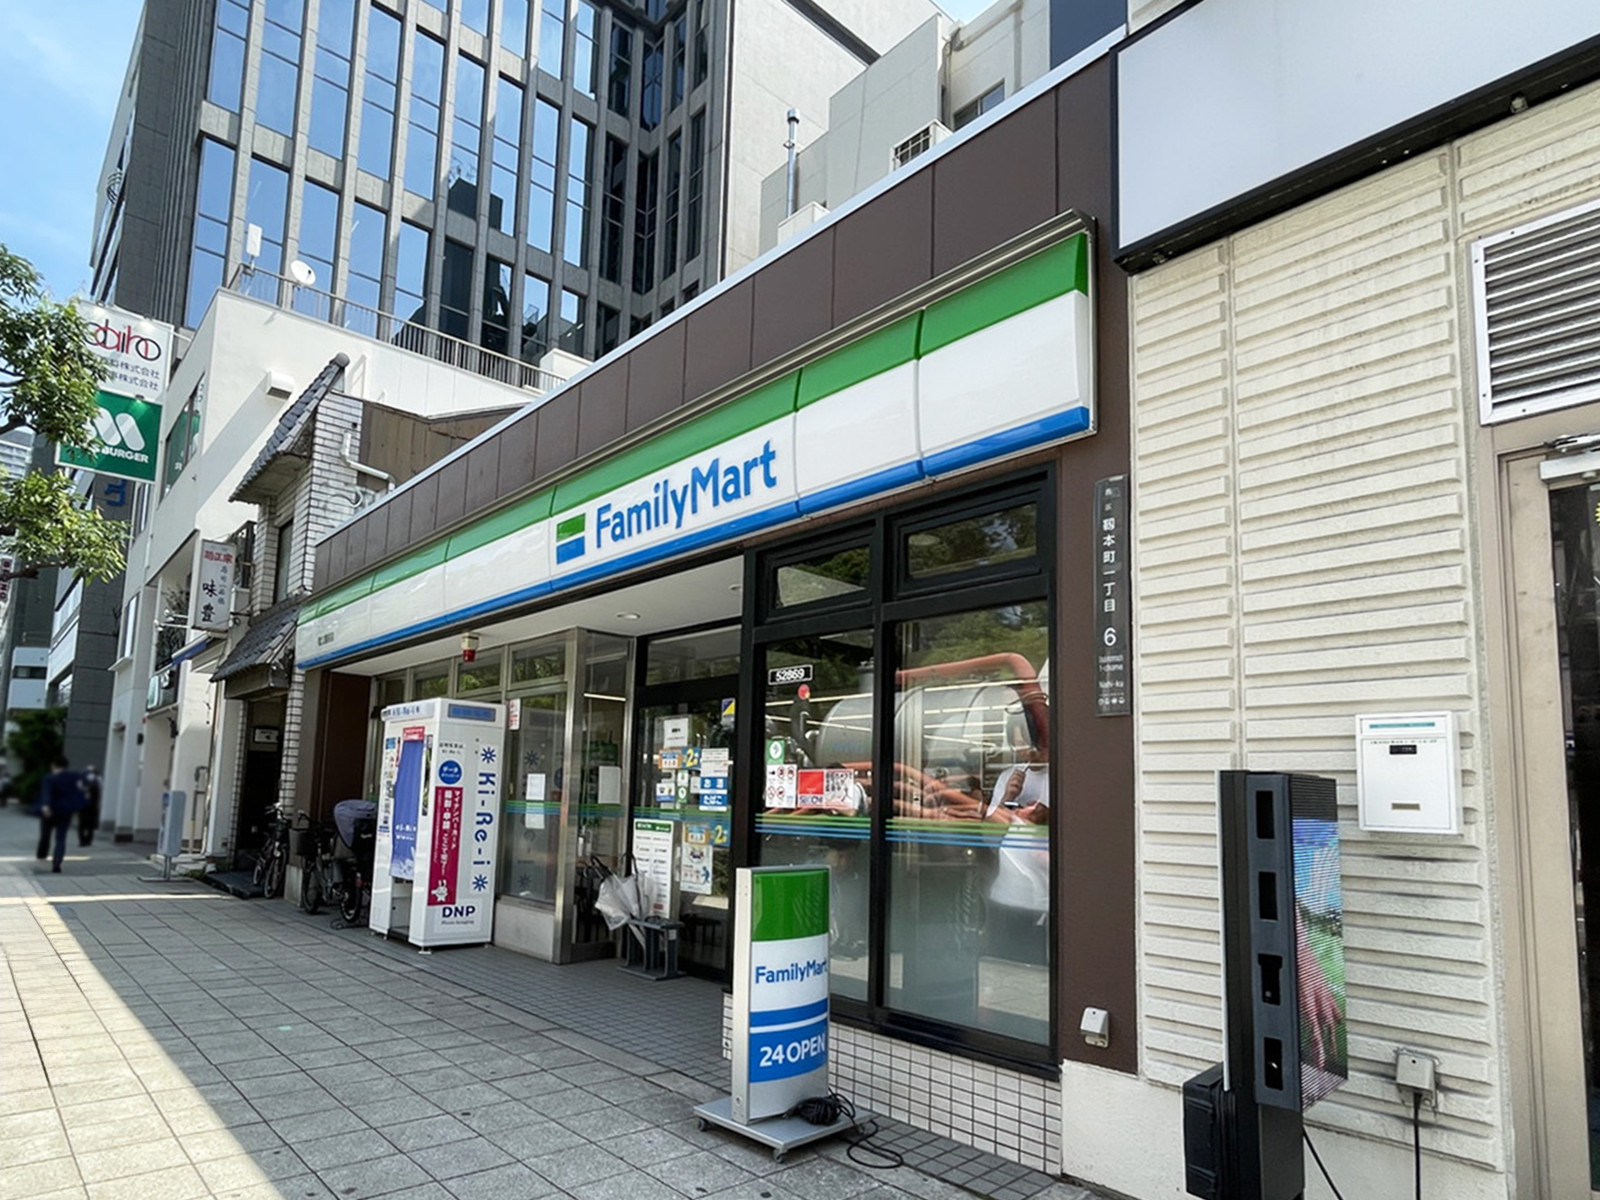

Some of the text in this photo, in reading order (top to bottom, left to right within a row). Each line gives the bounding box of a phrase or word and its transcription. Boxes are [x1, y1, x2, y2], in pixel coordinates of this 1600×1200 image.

[101, 448, 149, 464] BURGER
[596, 440, 777, 548] FamilyMart
[1103, 626, 1117, 647] 6
[473, 772, 497, 865] Ki-Re-i
[442, 905, 476, 918] DNP
[754, 957, 828, 985] FamilyMart
